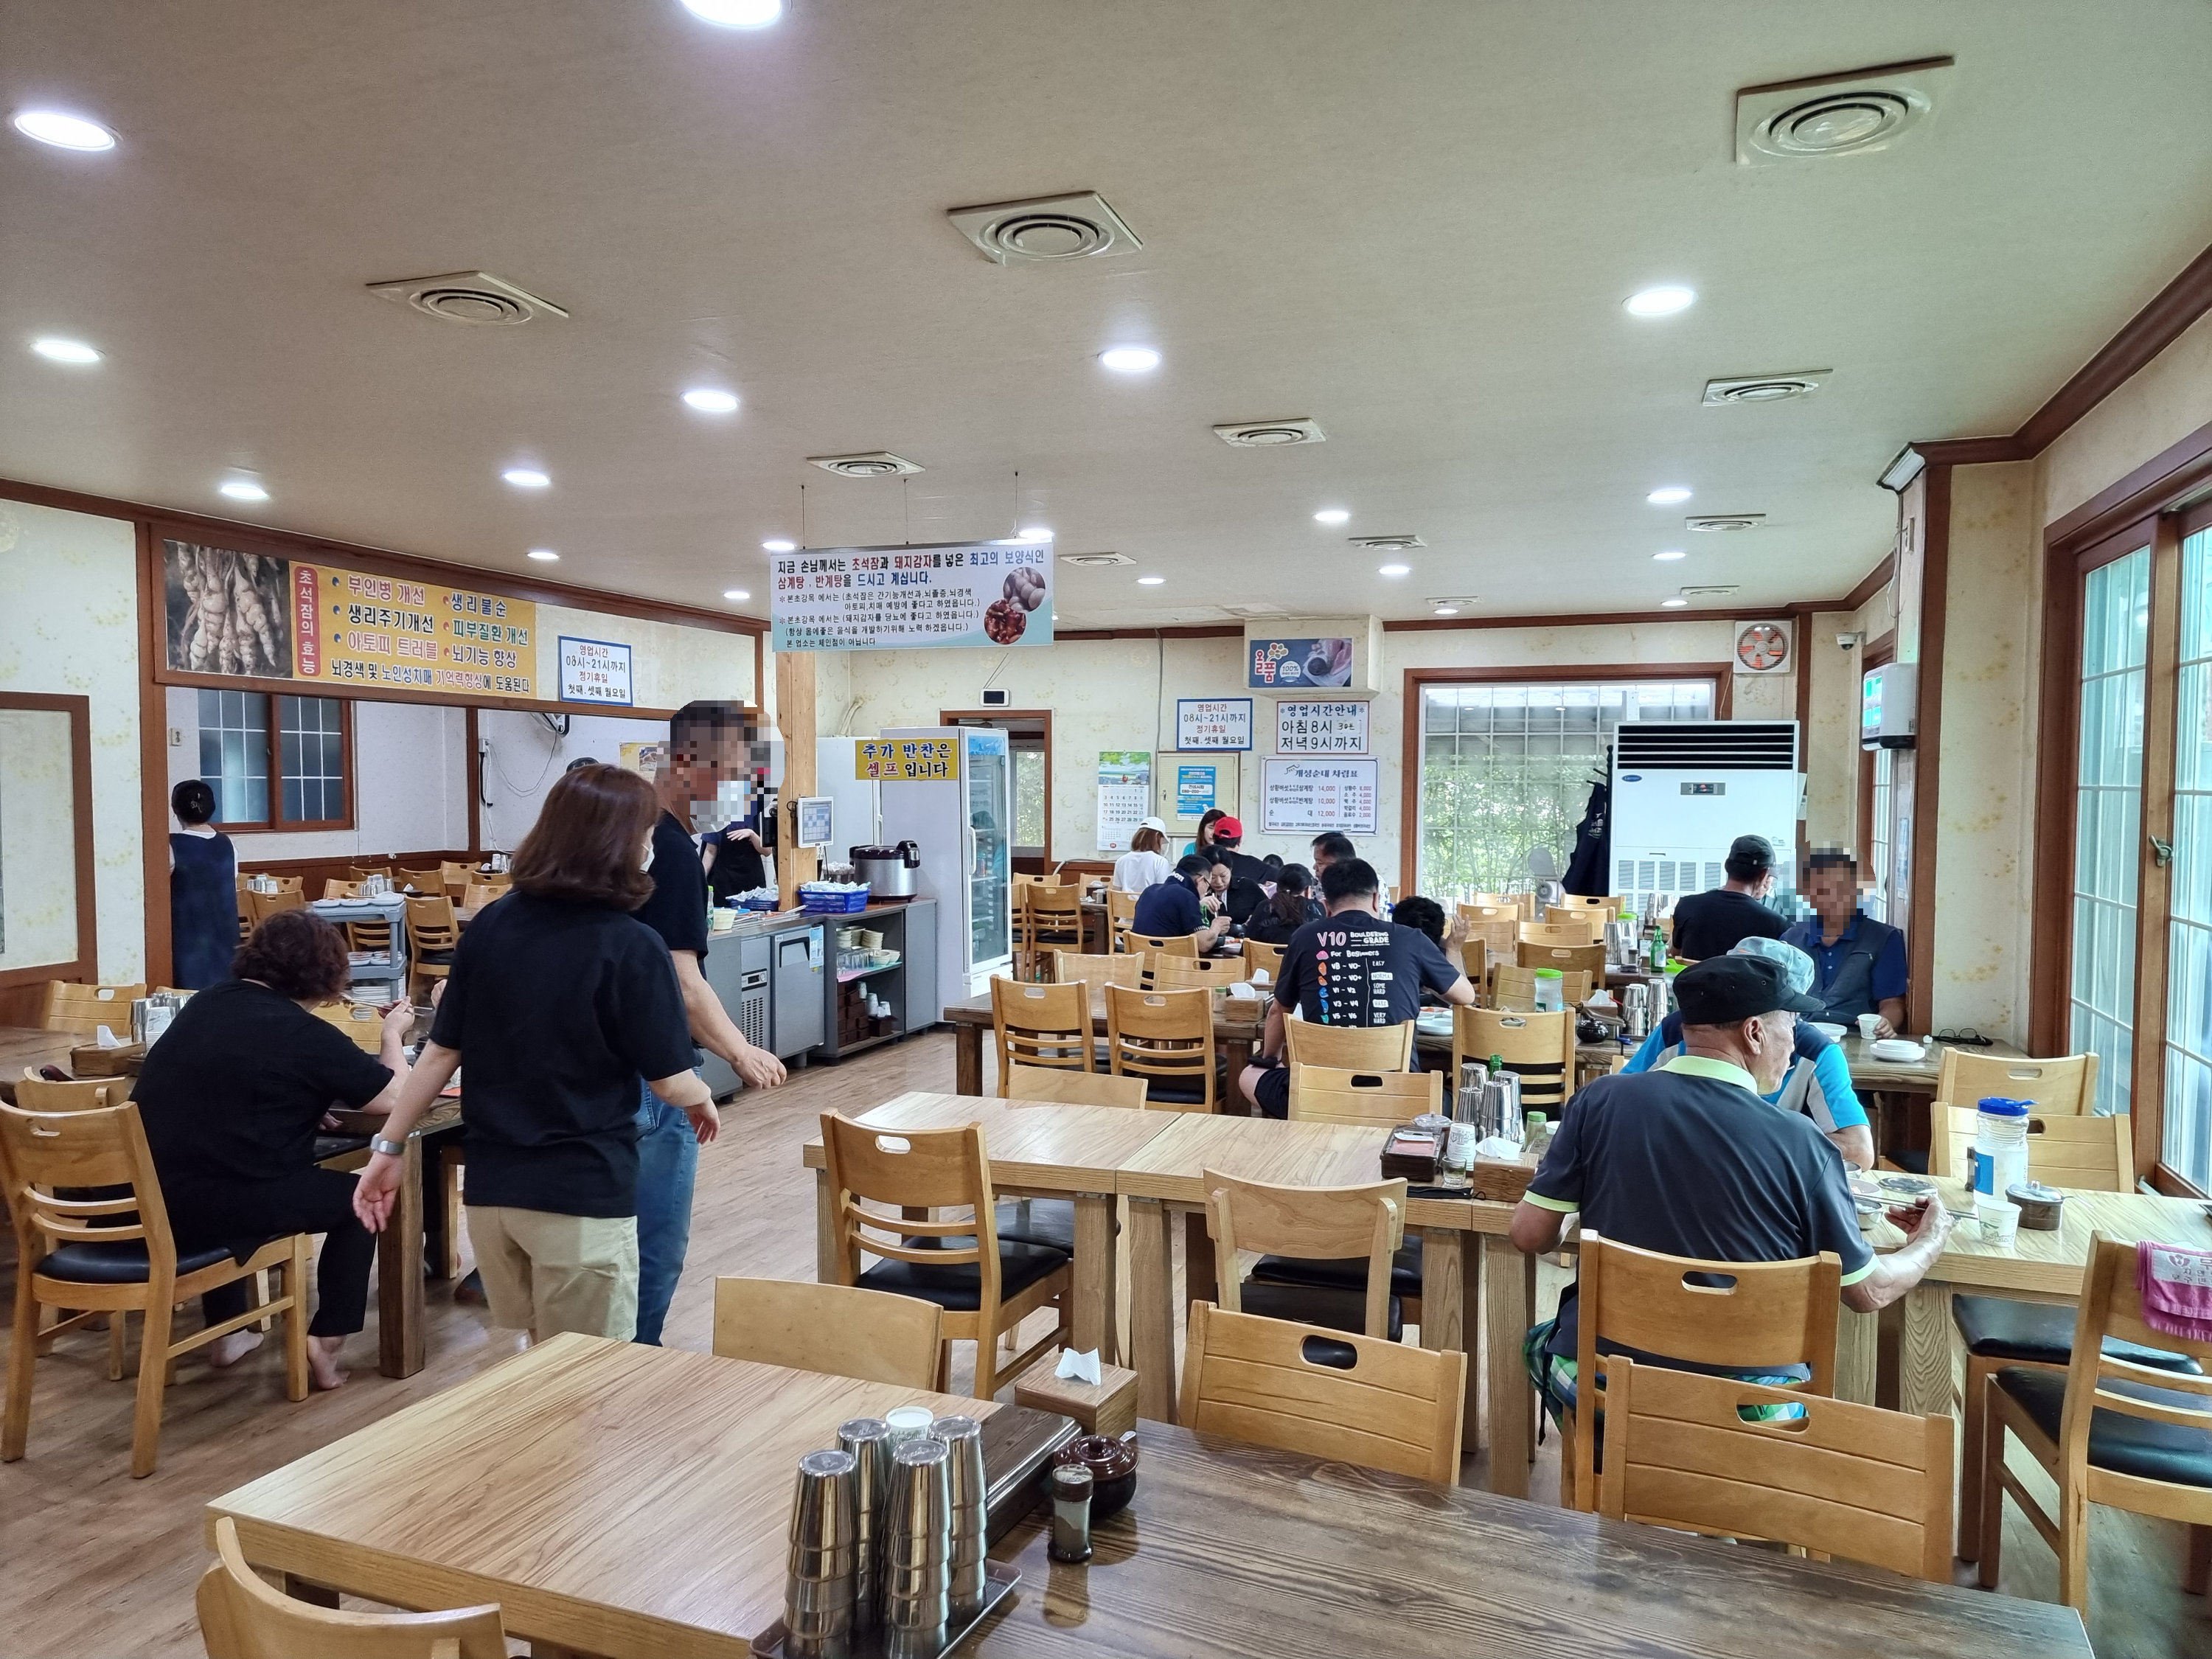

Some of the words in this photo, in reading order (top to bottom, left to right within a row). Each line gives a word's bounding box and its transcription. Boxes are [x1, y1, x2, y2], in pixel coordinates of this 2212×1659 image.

[778, 560, 796, 574] 지금
[801, 559, 846, 573] 손님께서는
[852, 556, 888, 571] 초석잠과
[894, 554, 942, 569] 돼지감자를
[945, 553, 964, 567] 넣은
[970, 552, 998, 566] 최고의
[1005, 549, 1044, 564] 보양식인
[778, 576, 805, 590] 삼계탕
[815, 574, 852, 588] 반계탕을
[858, 572, 885, 586] 드시고
[891, 571, 932, 585] 계십니다.
[348, 574, 392, 602] 부인병
[397, 584, 425, 606] 개선
[787, 594, 815, 603] 본초강목
[818, 593, 839, 602] 에서는
[842, 591, 874, 602] (초석잠은
[299, 570, 313, 636] 초석잠의
[451, 592, 507, 618] 생리불순
[844, 601, 883, 611] 아토피,치매
[886, 600, 908, 610] 예방에
[911, 599, 933, 609] 좋다고
[349, 604, 434, 633] 생리주기개선
[787, 615, 815, 625] 본초강목
[818, 614, 840, 623] 에서는
[842, 613, 882, 623] (돼지감자를
[885, 612, 907, 621] 당뇨에
[910, 611, 932, 620] 좋다고
[453, 619, 502, 643] 피부질환
[506, 627, 529, 646] 개선
[785, 627, 802, 636] (항상
[837, 625, 858, 635] 음식을
[861, 624, 905, 634] 개발하기위해
[908, 623, 922, 633] 노력
[347, 631, 392, 655] 아토피
[397, 638, 437, 660] 트러블
[787, 639, 793, 647] 본
[796, 639, 815, 647] 업소는
[818, 638, 845, 647] 체인점이
[849, 637, 876, 646] 아닙니다
[302, 641, 315, 674] 효능
[452, 644, 489, 666] 뇌기능
[493, 650, 517, 669] 향상
[580, 644, 609, 658] 영업시간
[566, 655, 626, 673] 08시~21시까지
[332, 659, 366, 679] 뇌경색
[368, 663, 378, 680] 및
[382, 664, 432, 685] 노인성치매
[436, 669, 492, 690] 기억력향상에
[495, 675, 530, 694] 도움된다
[579, 671, 608, 684] 정기휴일
[605, 686, 625, 698] 월요일
[1197, 703, 1227, 712] 영업시간
[1287, 704, 1357, 717] 영업시간안내
[1183, 713, 1246, 723] 08시~21시까지
[1196, 725, 1226, 734] 정기휴일
[1222, 736, 1245, 745] 월요일
[862, 743, 894, 759] 추가
[902, 742, 951, 759] 반찬은
[866, 761, 899, 777] 셀프
[905, 761, 948, 777] 입니다
[1295, 769, 1329, 778] 개성순대
[1332, 769, 1358, 778] 차림표
[1317, 931, 1346, 947] V10
